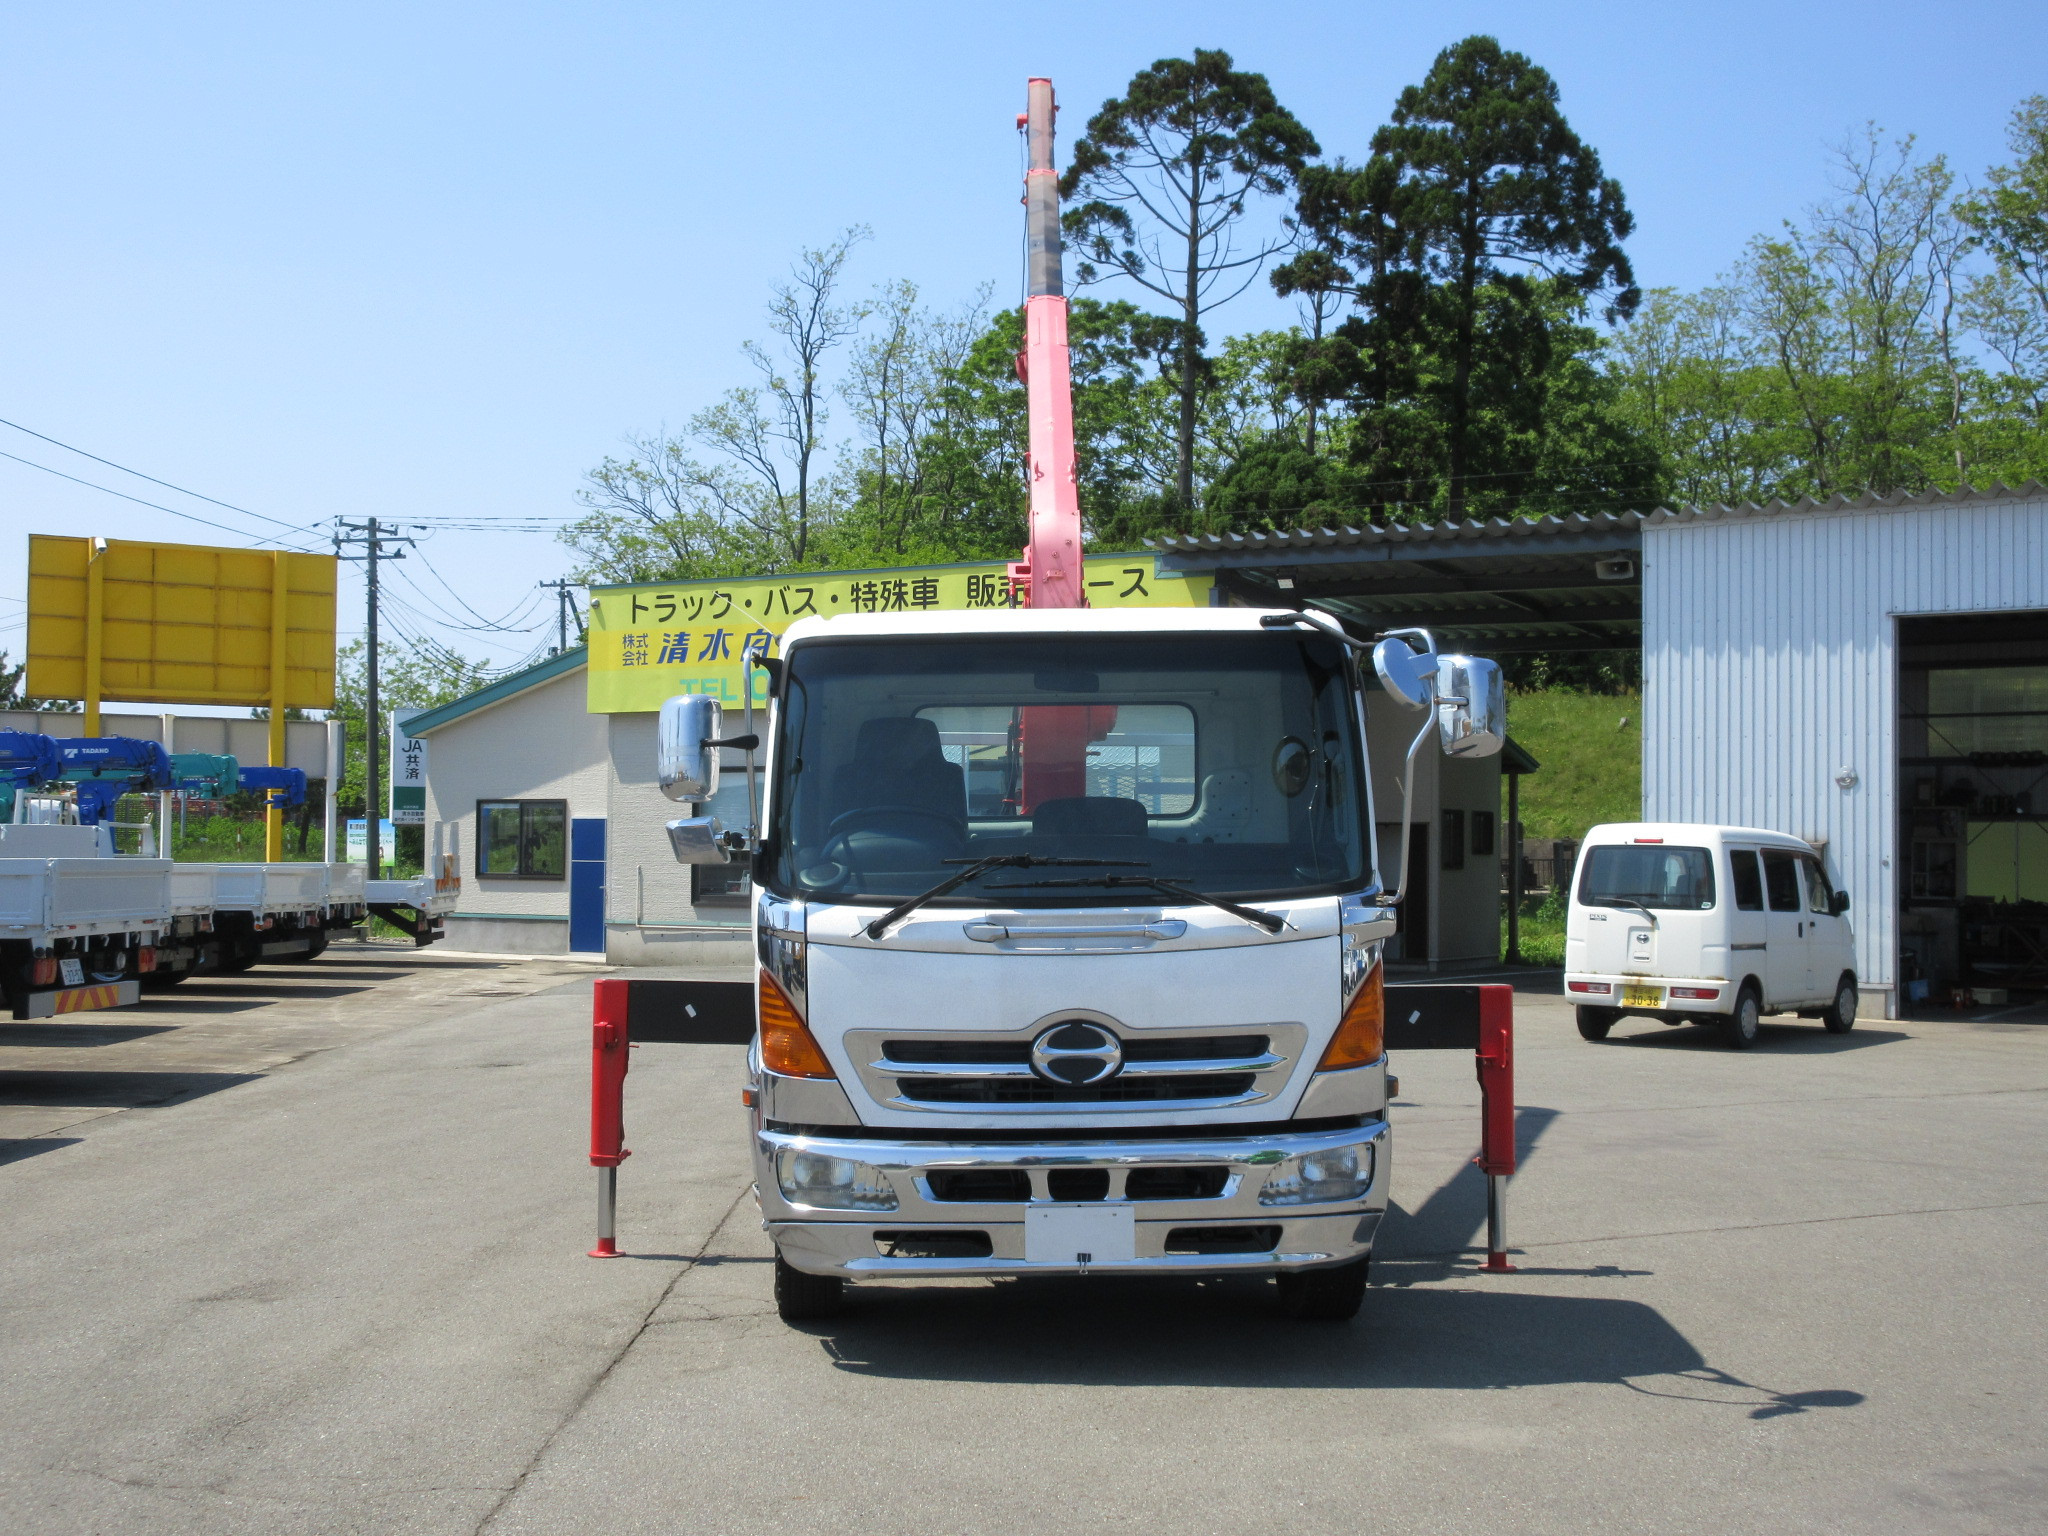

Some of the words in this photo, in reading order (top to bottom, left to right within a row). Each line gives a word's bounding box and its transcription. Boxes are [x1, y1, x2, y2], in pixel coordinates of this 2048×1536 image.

[632, 576, 939, 624] トラック・バス・特殊車
[622, 633, 648, 649] 株式
[622, 650, 648, 666] 会社
[679, 677, 738, 701] TEL
[1631, 995, 1659, 1006] 30-38
